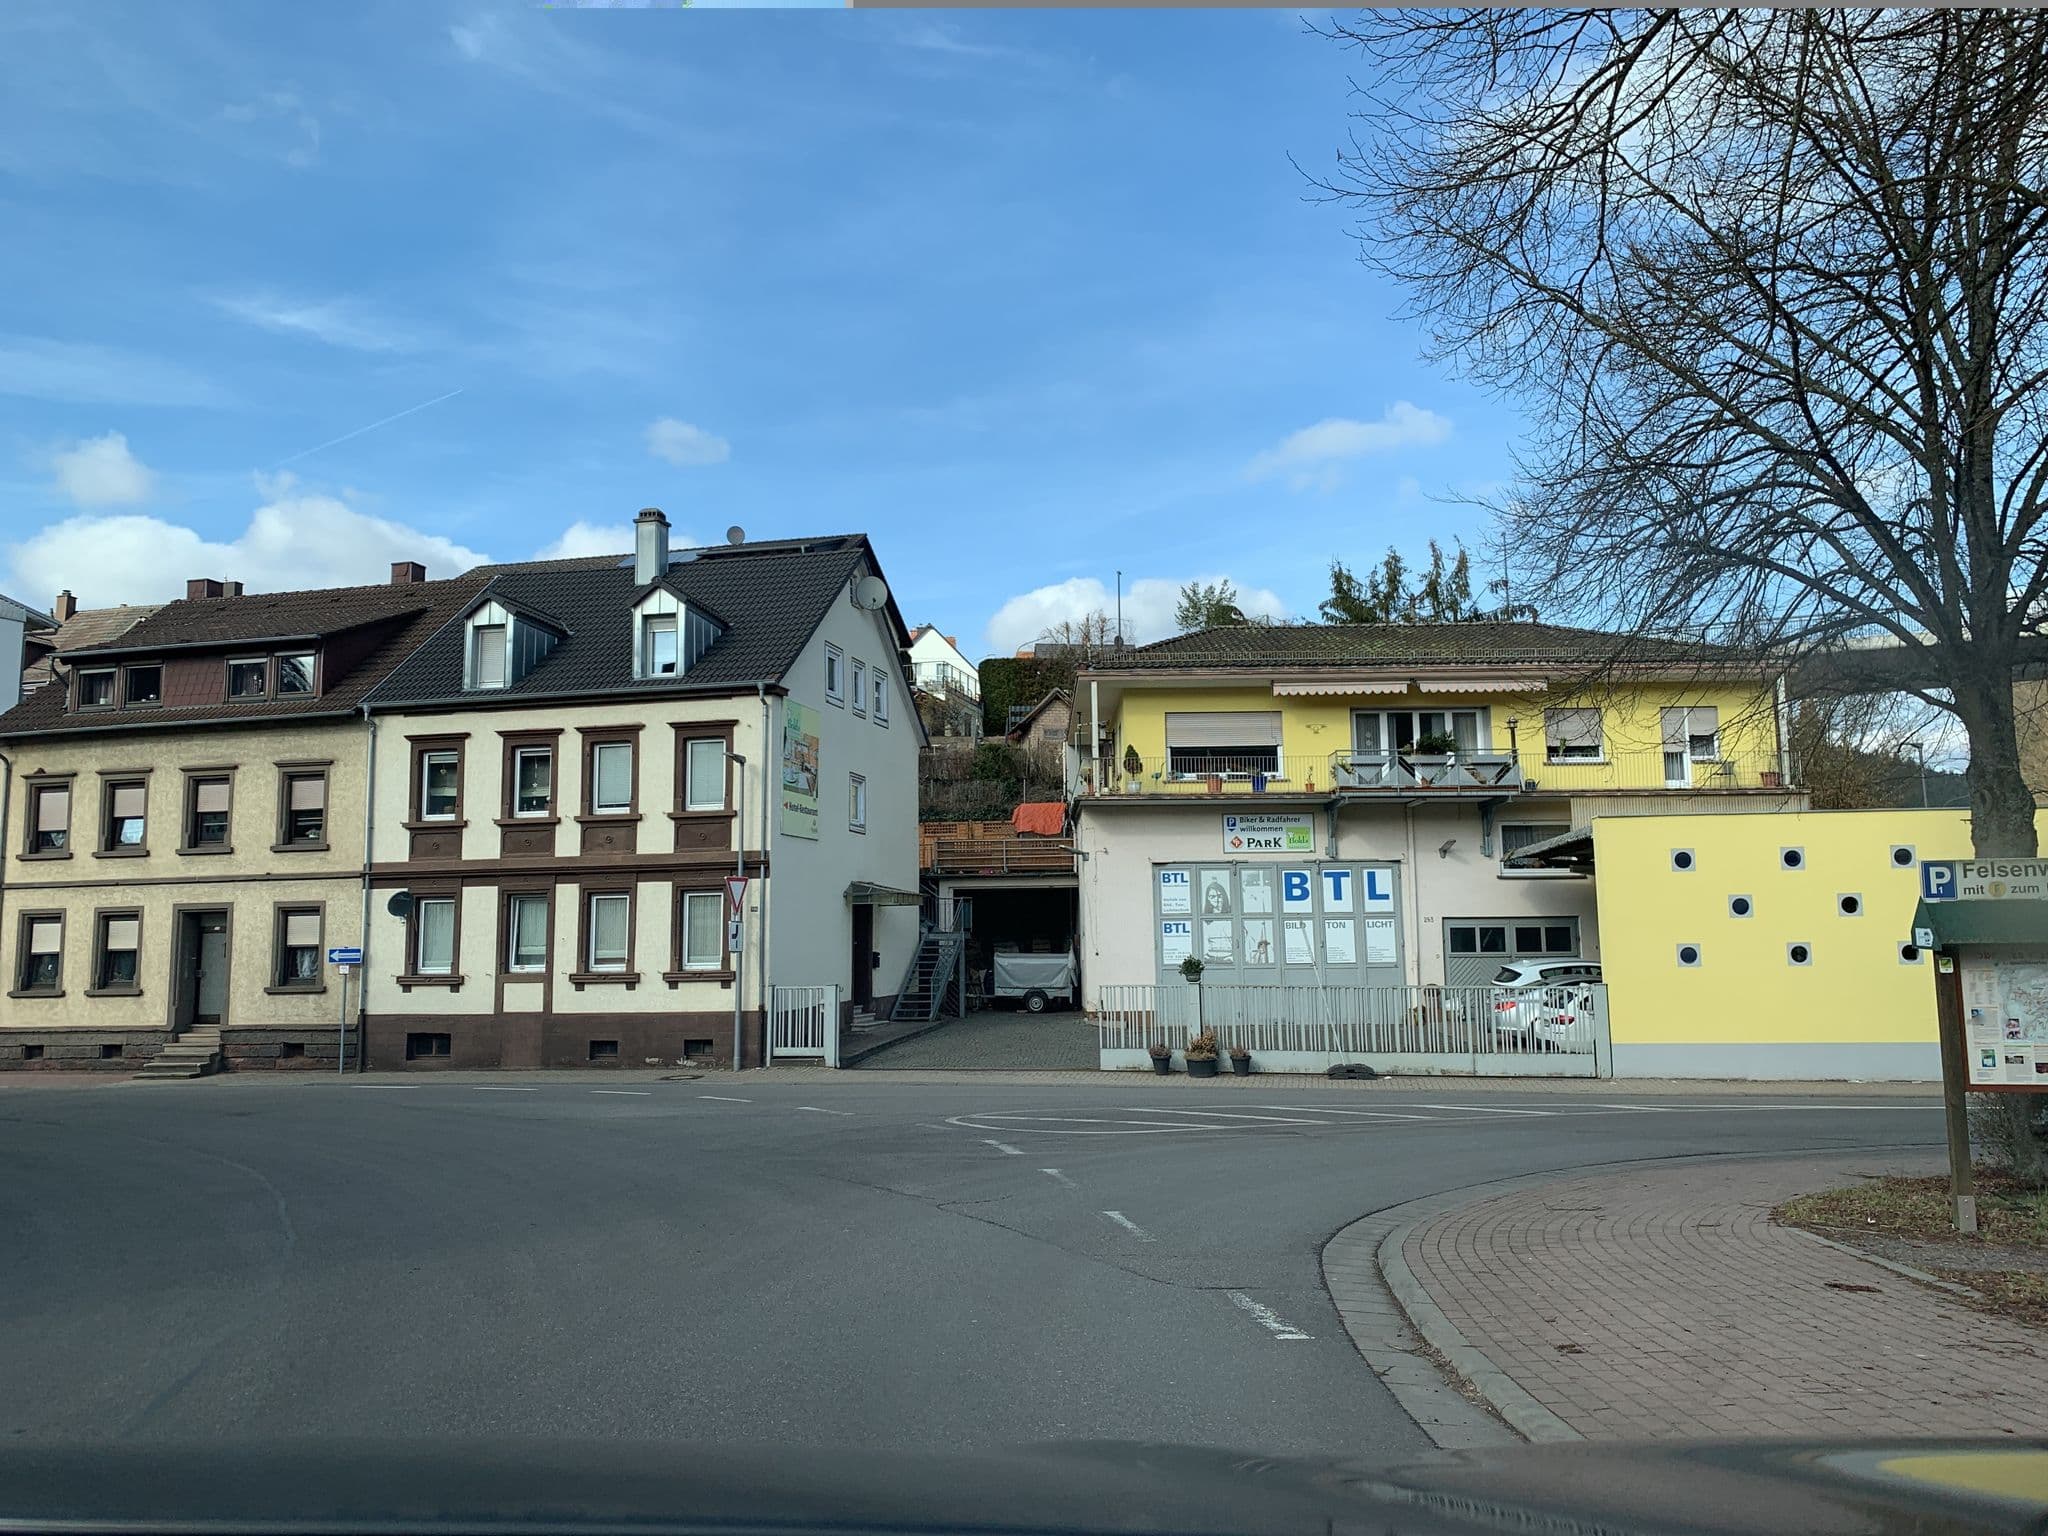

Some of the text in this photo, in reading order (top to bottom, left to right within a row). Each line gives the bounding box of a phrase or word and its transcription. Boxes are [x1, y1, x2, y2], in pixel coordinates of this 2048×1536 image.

[1267, 815, 1300, 823] Radfahrer
[1162, 872, 1189, 883] BTL
[1929, 866, 1951, 894] P
[1938, 886, 1943, 894] 1
[1963, 885, 1985, 895] mit
[2011, 885, 2040, 894] zum
[1164, 923, 1190, 933] BTL
[1366, 920, 1393, 928] LICHT
